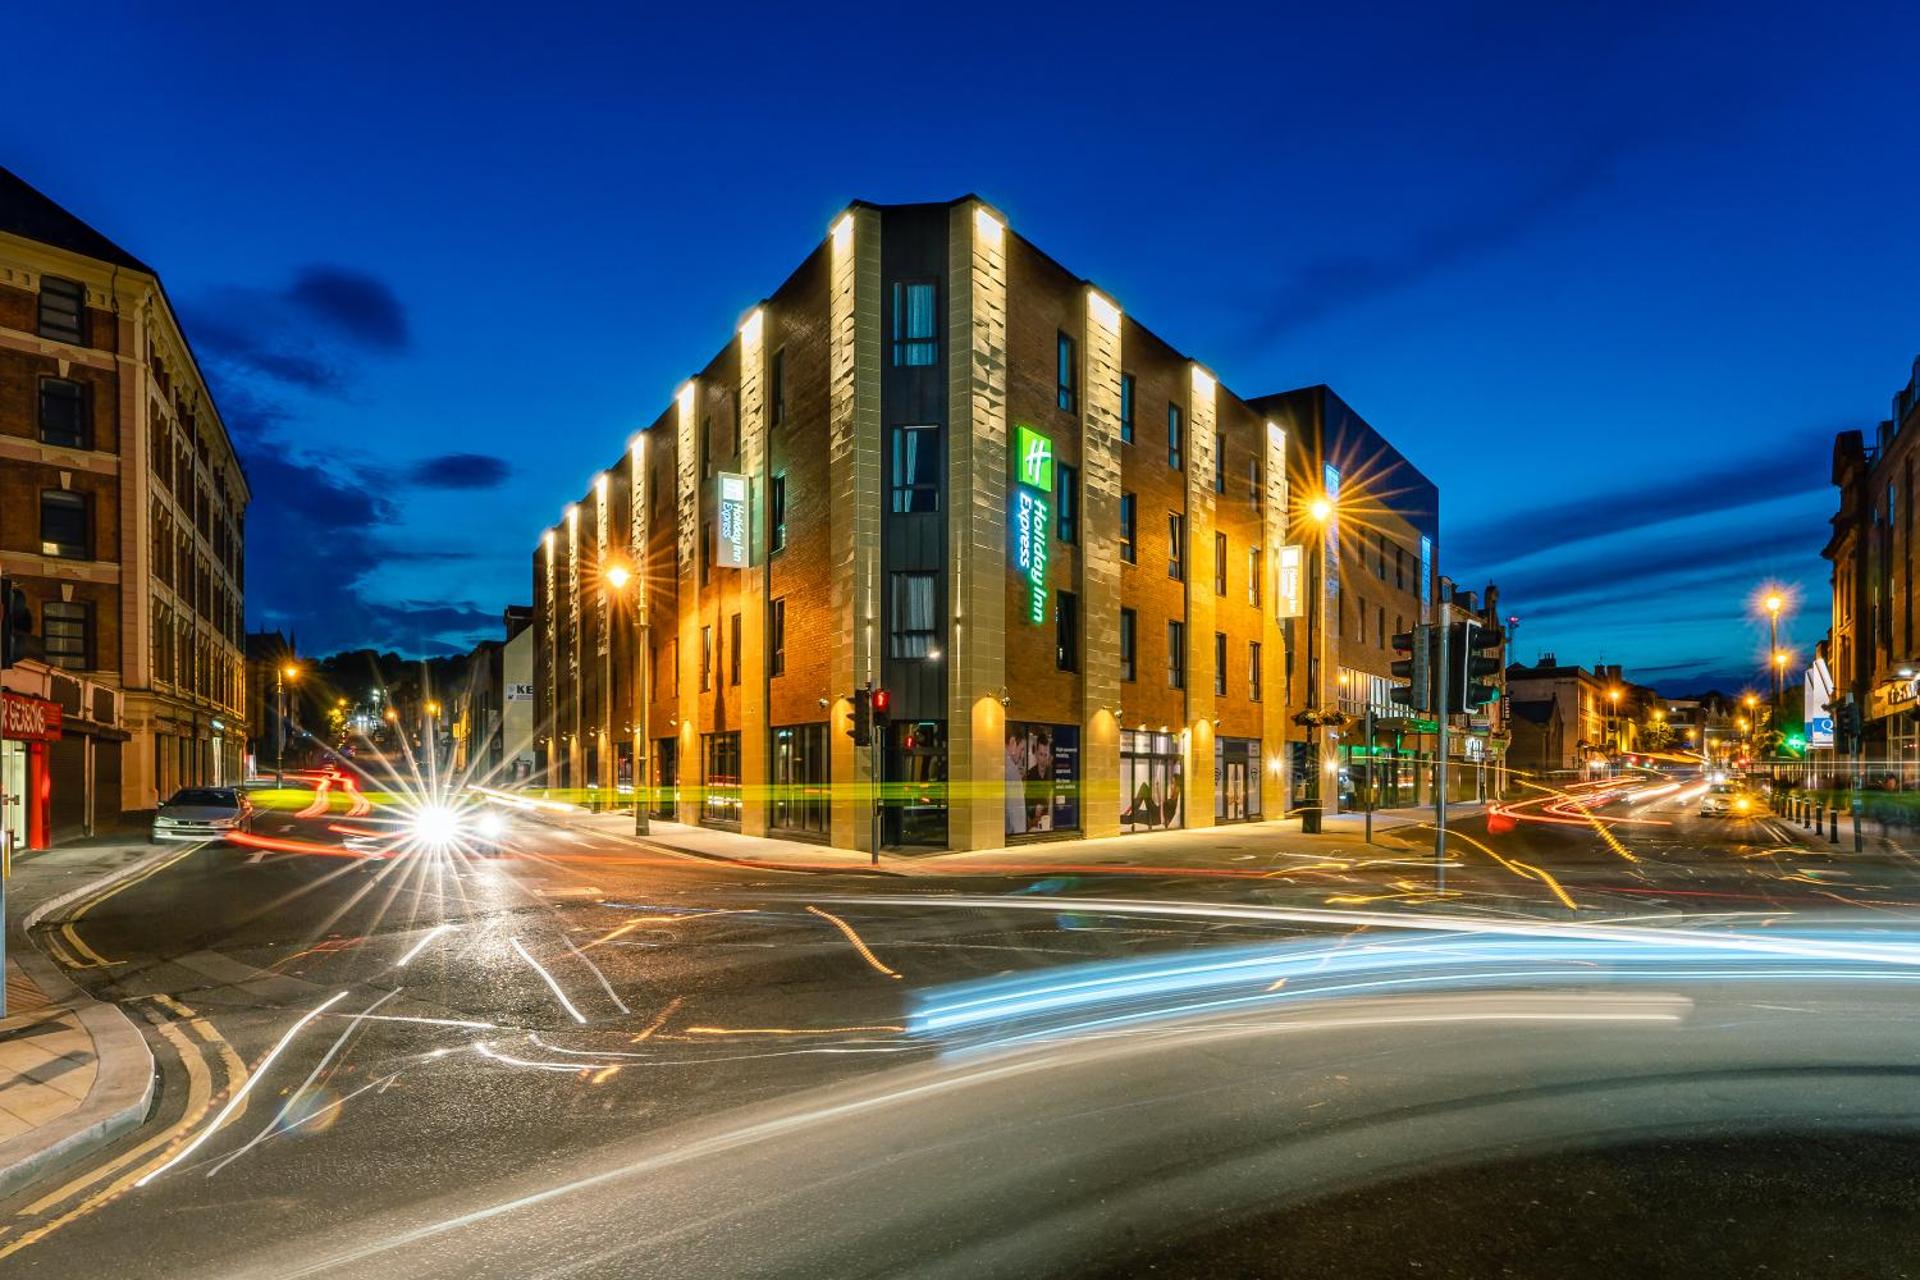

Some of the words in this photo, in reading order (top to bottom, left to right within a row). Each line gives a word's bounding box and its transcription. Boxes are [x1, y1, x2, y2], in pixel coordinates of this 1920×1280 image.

[721, 502, 733, 539] Express
[731, 503, 744, 545] Holiday
[1019, 492, 1033, 568] Express
[733, 545, 744, 562] Inn
[1031, 499, 1047, 585] Holiday
[1033, 587, 1047, 623] Inn
